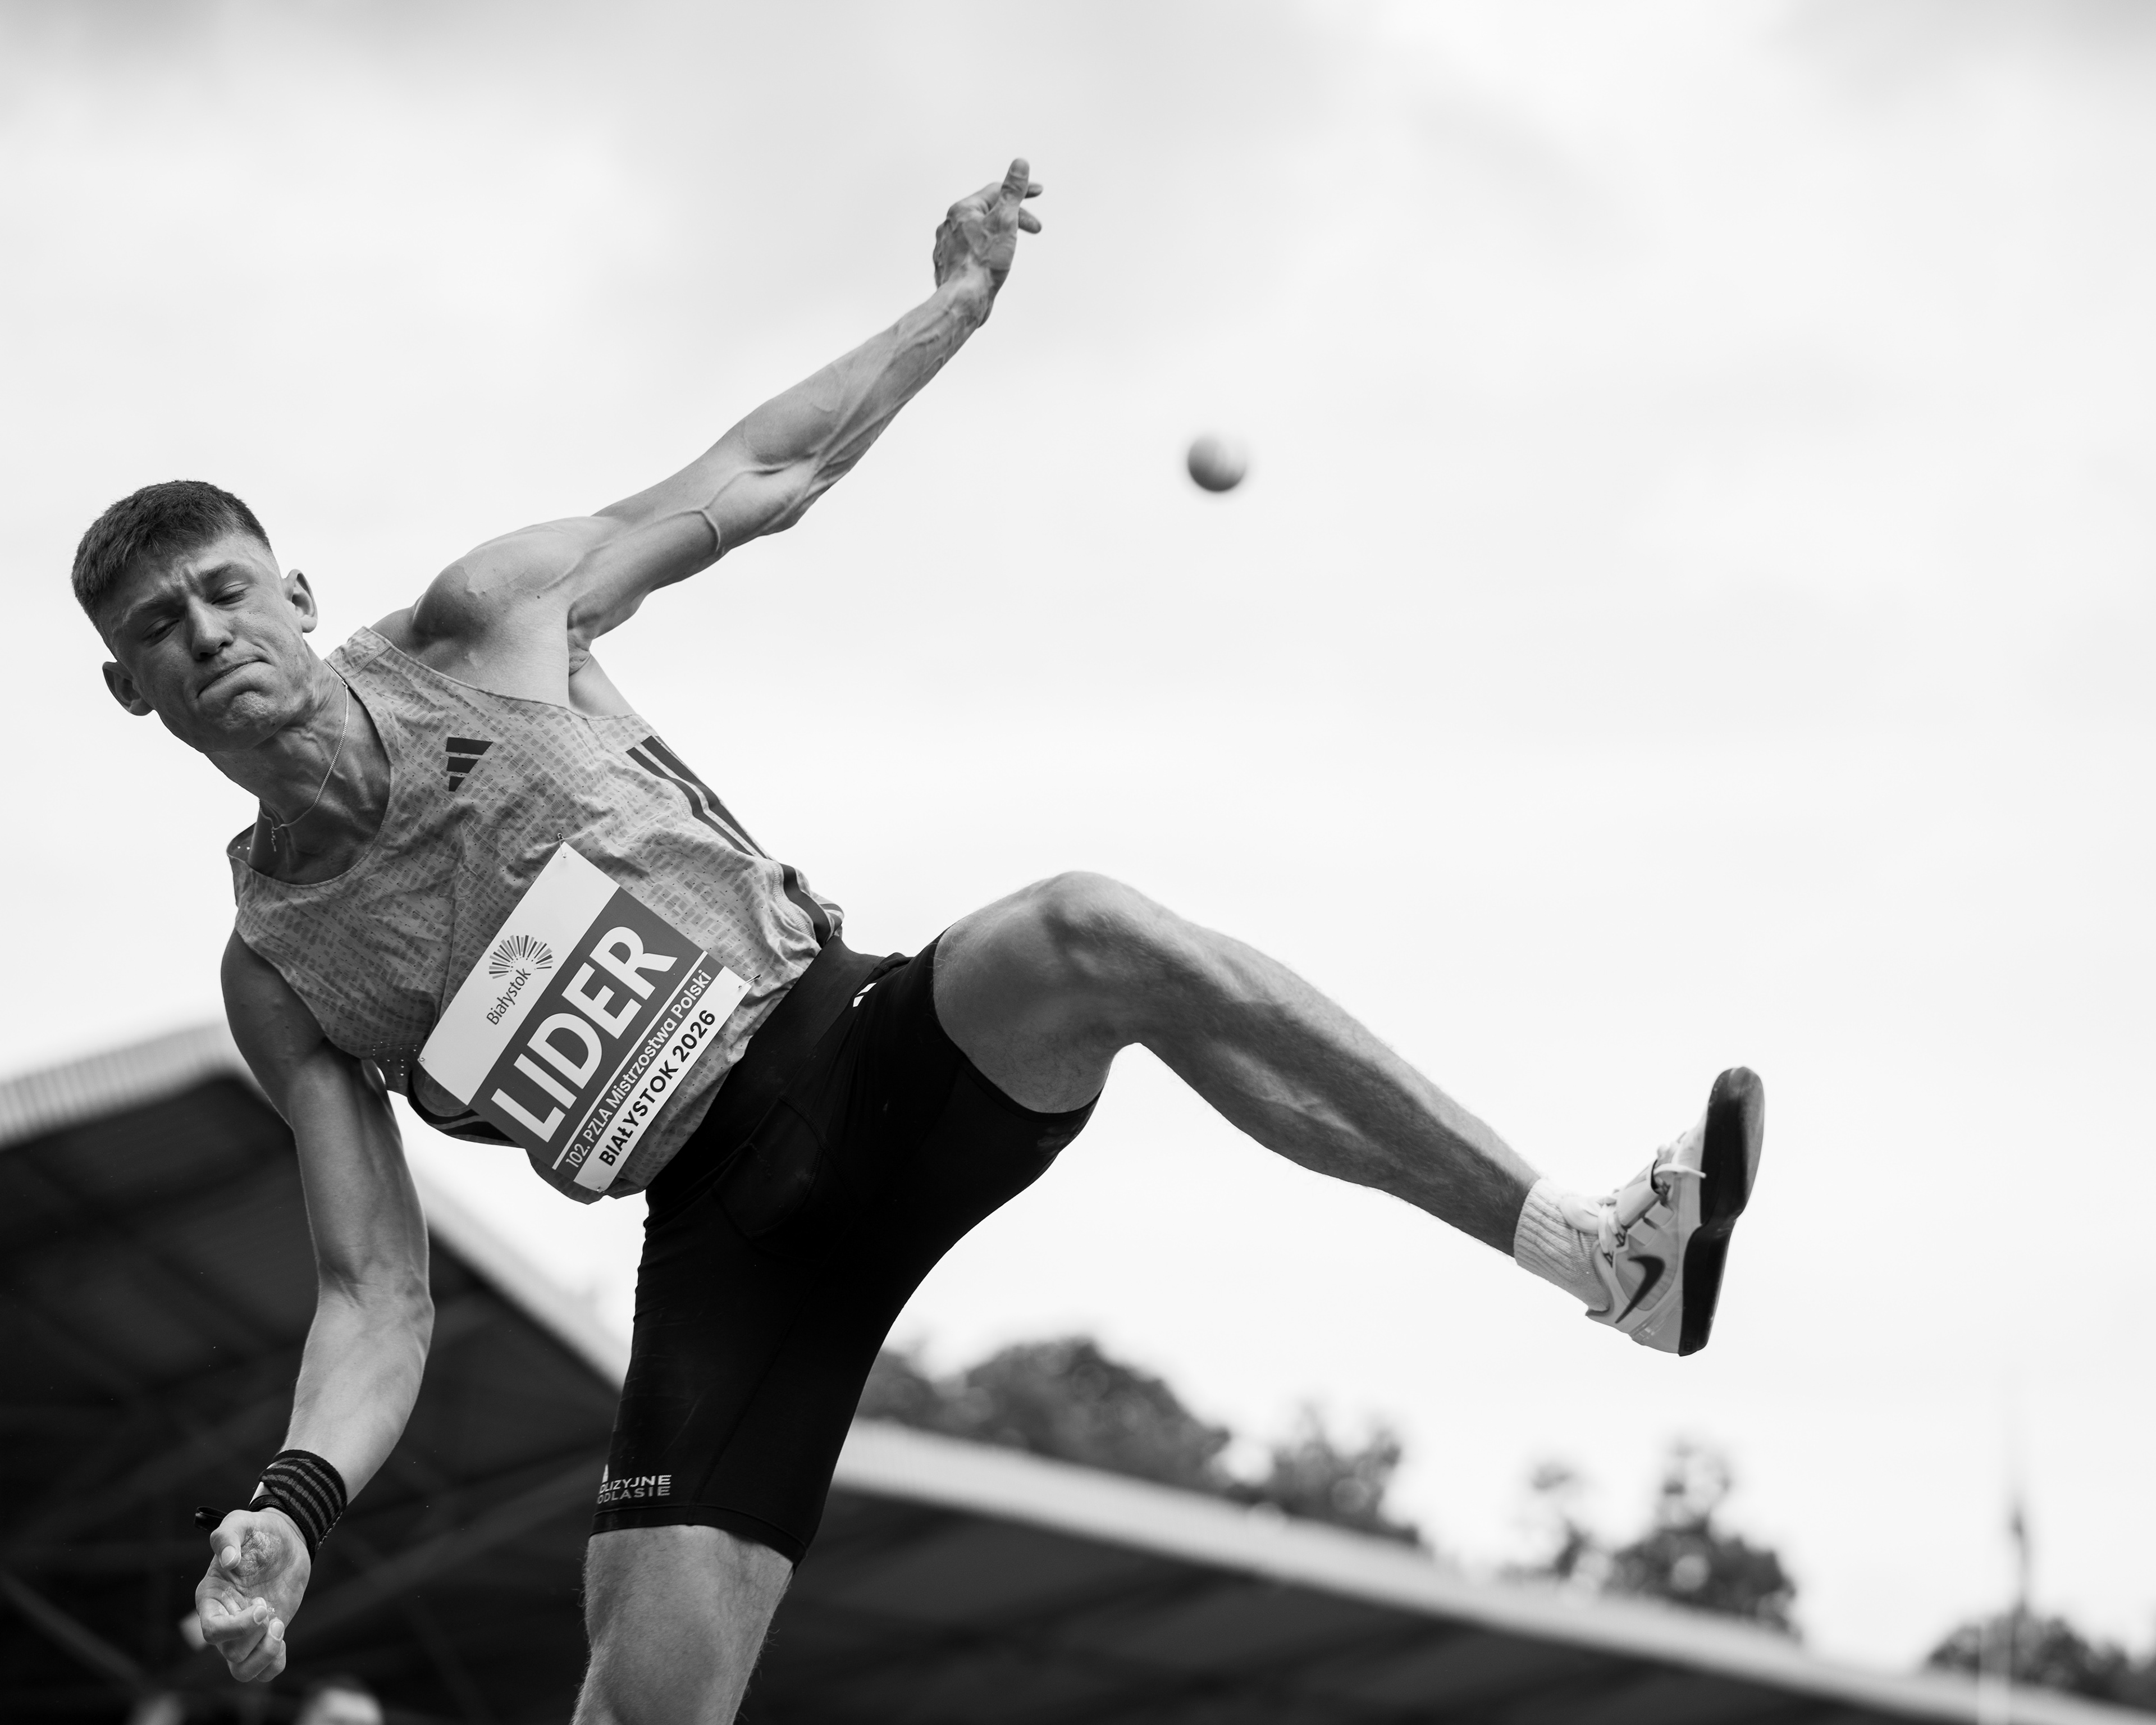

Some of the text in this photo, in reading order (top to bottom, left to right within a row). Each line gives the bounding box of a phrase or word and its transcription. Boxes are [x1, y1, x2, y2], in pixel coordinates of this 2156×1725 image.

[486, 968, 531, 1025] Białystok
[490, 927, 678, 1143] LIDER
[565, 969, 712, 1167] 102. PZLA Mistrzostwa Polski
[599, 1010, 715, 1166] BIAŁYSTOK 2026
[597, 1486, 671, 1504] ODLASIE
[599, 1475, 672, 1494] OLIZYJNE
